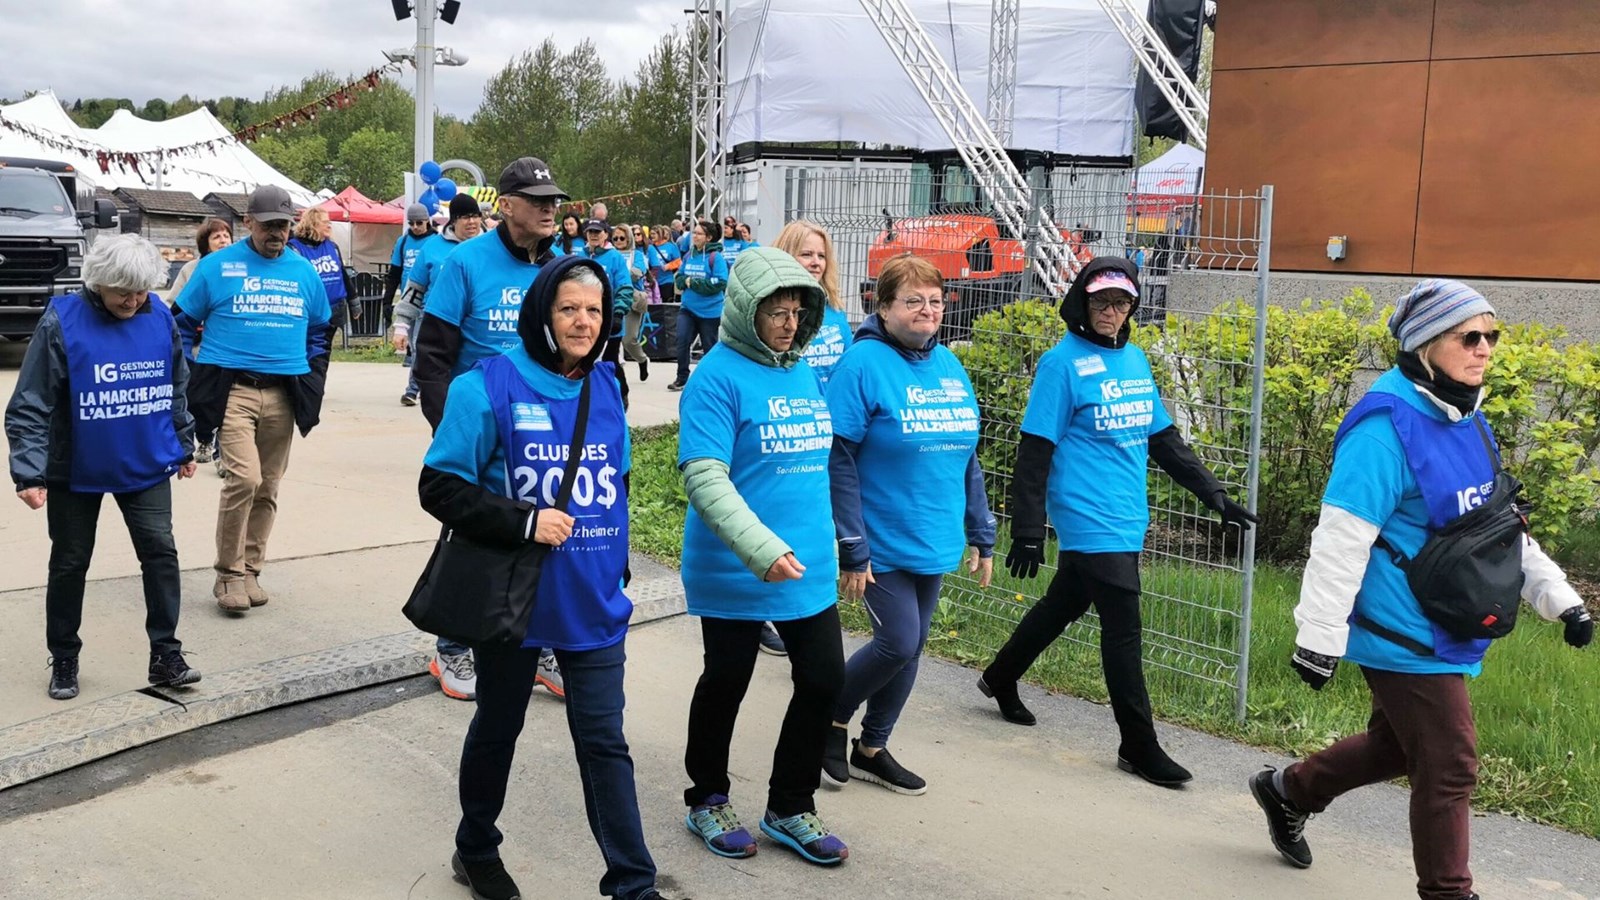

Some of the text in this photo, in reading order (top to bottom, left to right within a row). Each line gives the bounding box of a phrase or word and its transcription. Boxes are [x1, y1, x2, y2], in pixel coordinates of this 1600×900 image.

[243, 278, 261, 291] IG
[233, 294, 245, 304] LA
[246, 294, 282, 305] MARCHE
[501, 289, 521, 305] IG
[488, 309, 501, 321] LA
[94, 363, 118, 384] IG
[119, 360, 165, 371] GESTION DE
[120, 369, 165, 380] PATRIMOINE
[80, 384, 174, 407] LA MARCHE POUR
[905, 386, 927, 405] IG
[1100, 380, 1123, 401] IG
[768, 397, 792, 419] IG
[900, 409, 915, 421] LA
[914, 407, 954, 421] MARCHE
[1094, 405, 1110, 419] LA
[1110, 401, 1147, 417] MARCHE
[759, 425, 777, 440] LA
[777, 422, 817, 439] MARCHE
[761, 435, 833, 455] L'ALZHEIME
[514, 462, 618, 510] 200$
[1456, 486, 1483, 516] IG
